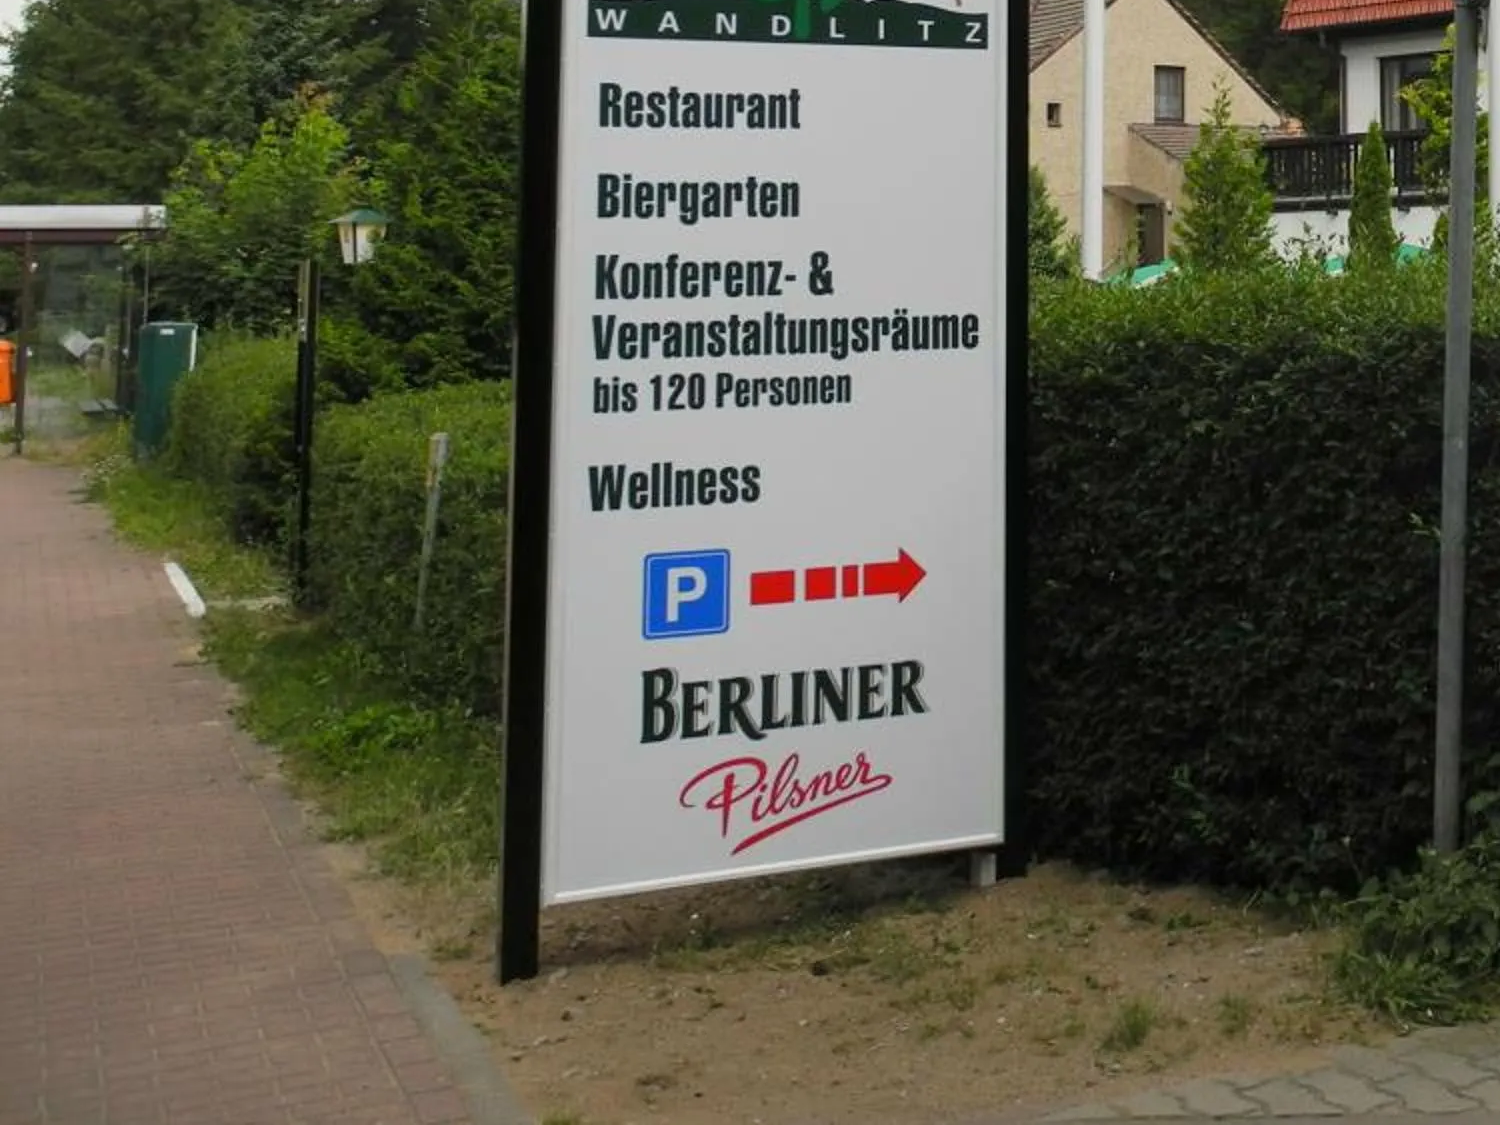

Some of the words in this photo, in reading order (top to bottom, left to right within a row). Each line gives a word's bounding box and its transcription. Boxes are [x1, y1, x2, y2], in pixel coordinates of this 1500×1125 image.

[595, 7, 983, 44] WANDLITZ
[599, 82, 801, 129] Restaurant
[596, 174, 800, 225] Biergarten
[595, 254, 797, 300] Konferenz-
[808, 251, 834, 296] &
[592, 309, 980, 361] Veranstaltungsräume
[592, 377, 638, 413] bis
[649, 373, 705, 410] 120
[715, 374, 852, 408] Personen
[588, 462, 761, 512] Wellness
[666, 566, 708, 623] P
[640, 660, 929, 744] BERLINER
[679, 752, 894, 857] Pilsner
